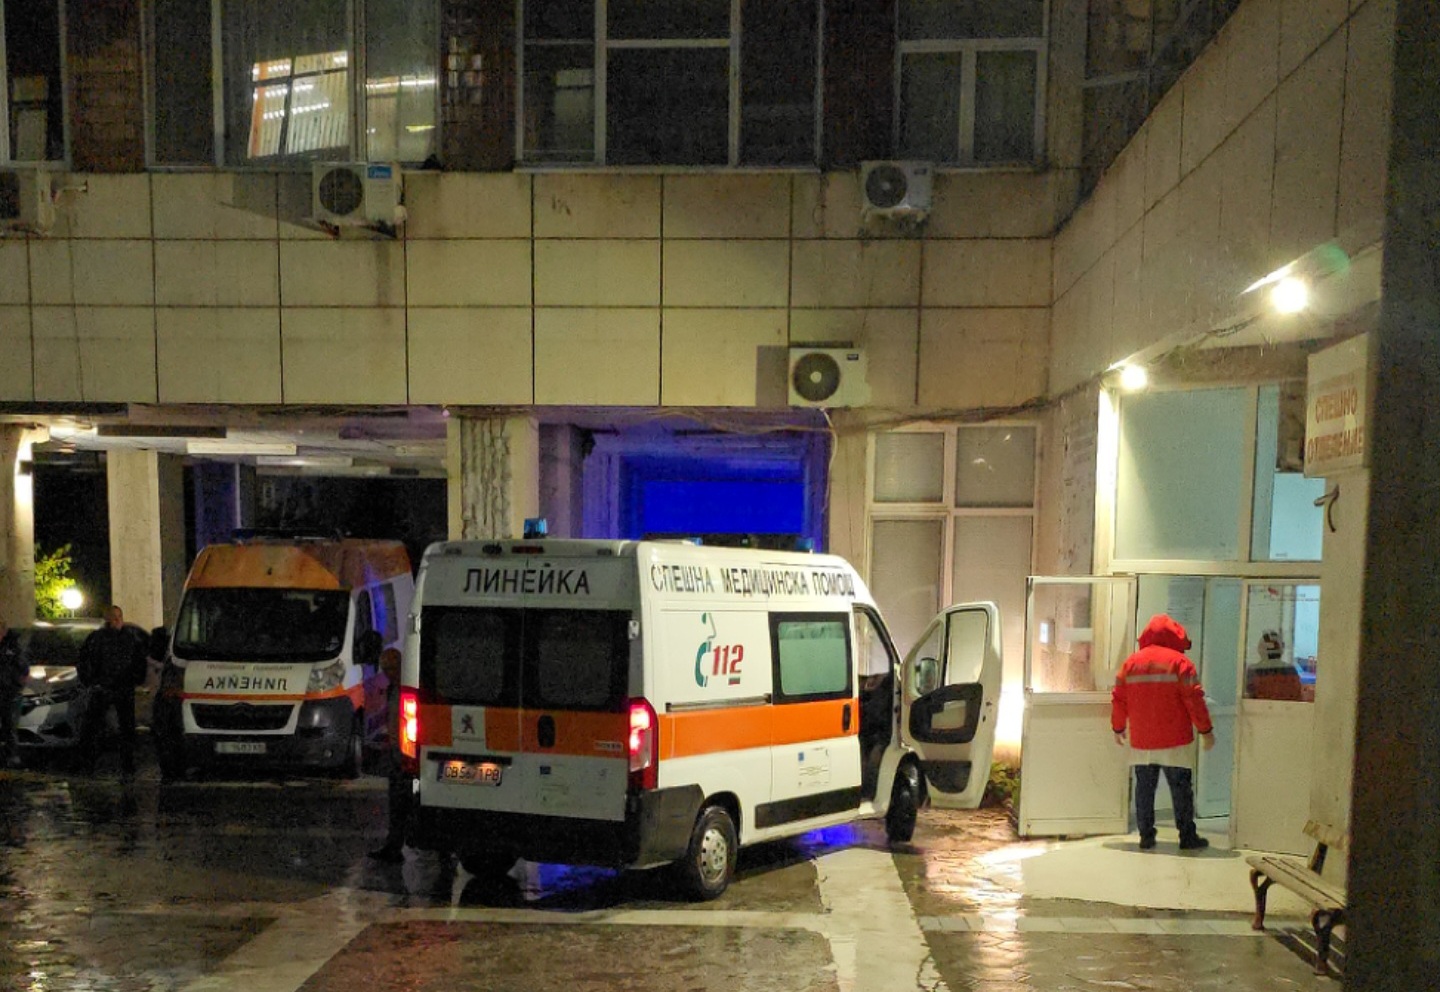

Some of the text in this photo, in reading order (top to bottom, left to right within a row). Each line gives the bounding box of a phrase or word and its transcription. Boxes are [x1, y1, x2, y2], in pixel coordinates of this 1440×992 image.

[463, 562, 590, 595] ЛИНЕЙКА
[650, 564, 856, 599] СПЕШНА МЕДИЦИНСКА ПОМОЩ
[711, 644, 745, 676] 112
